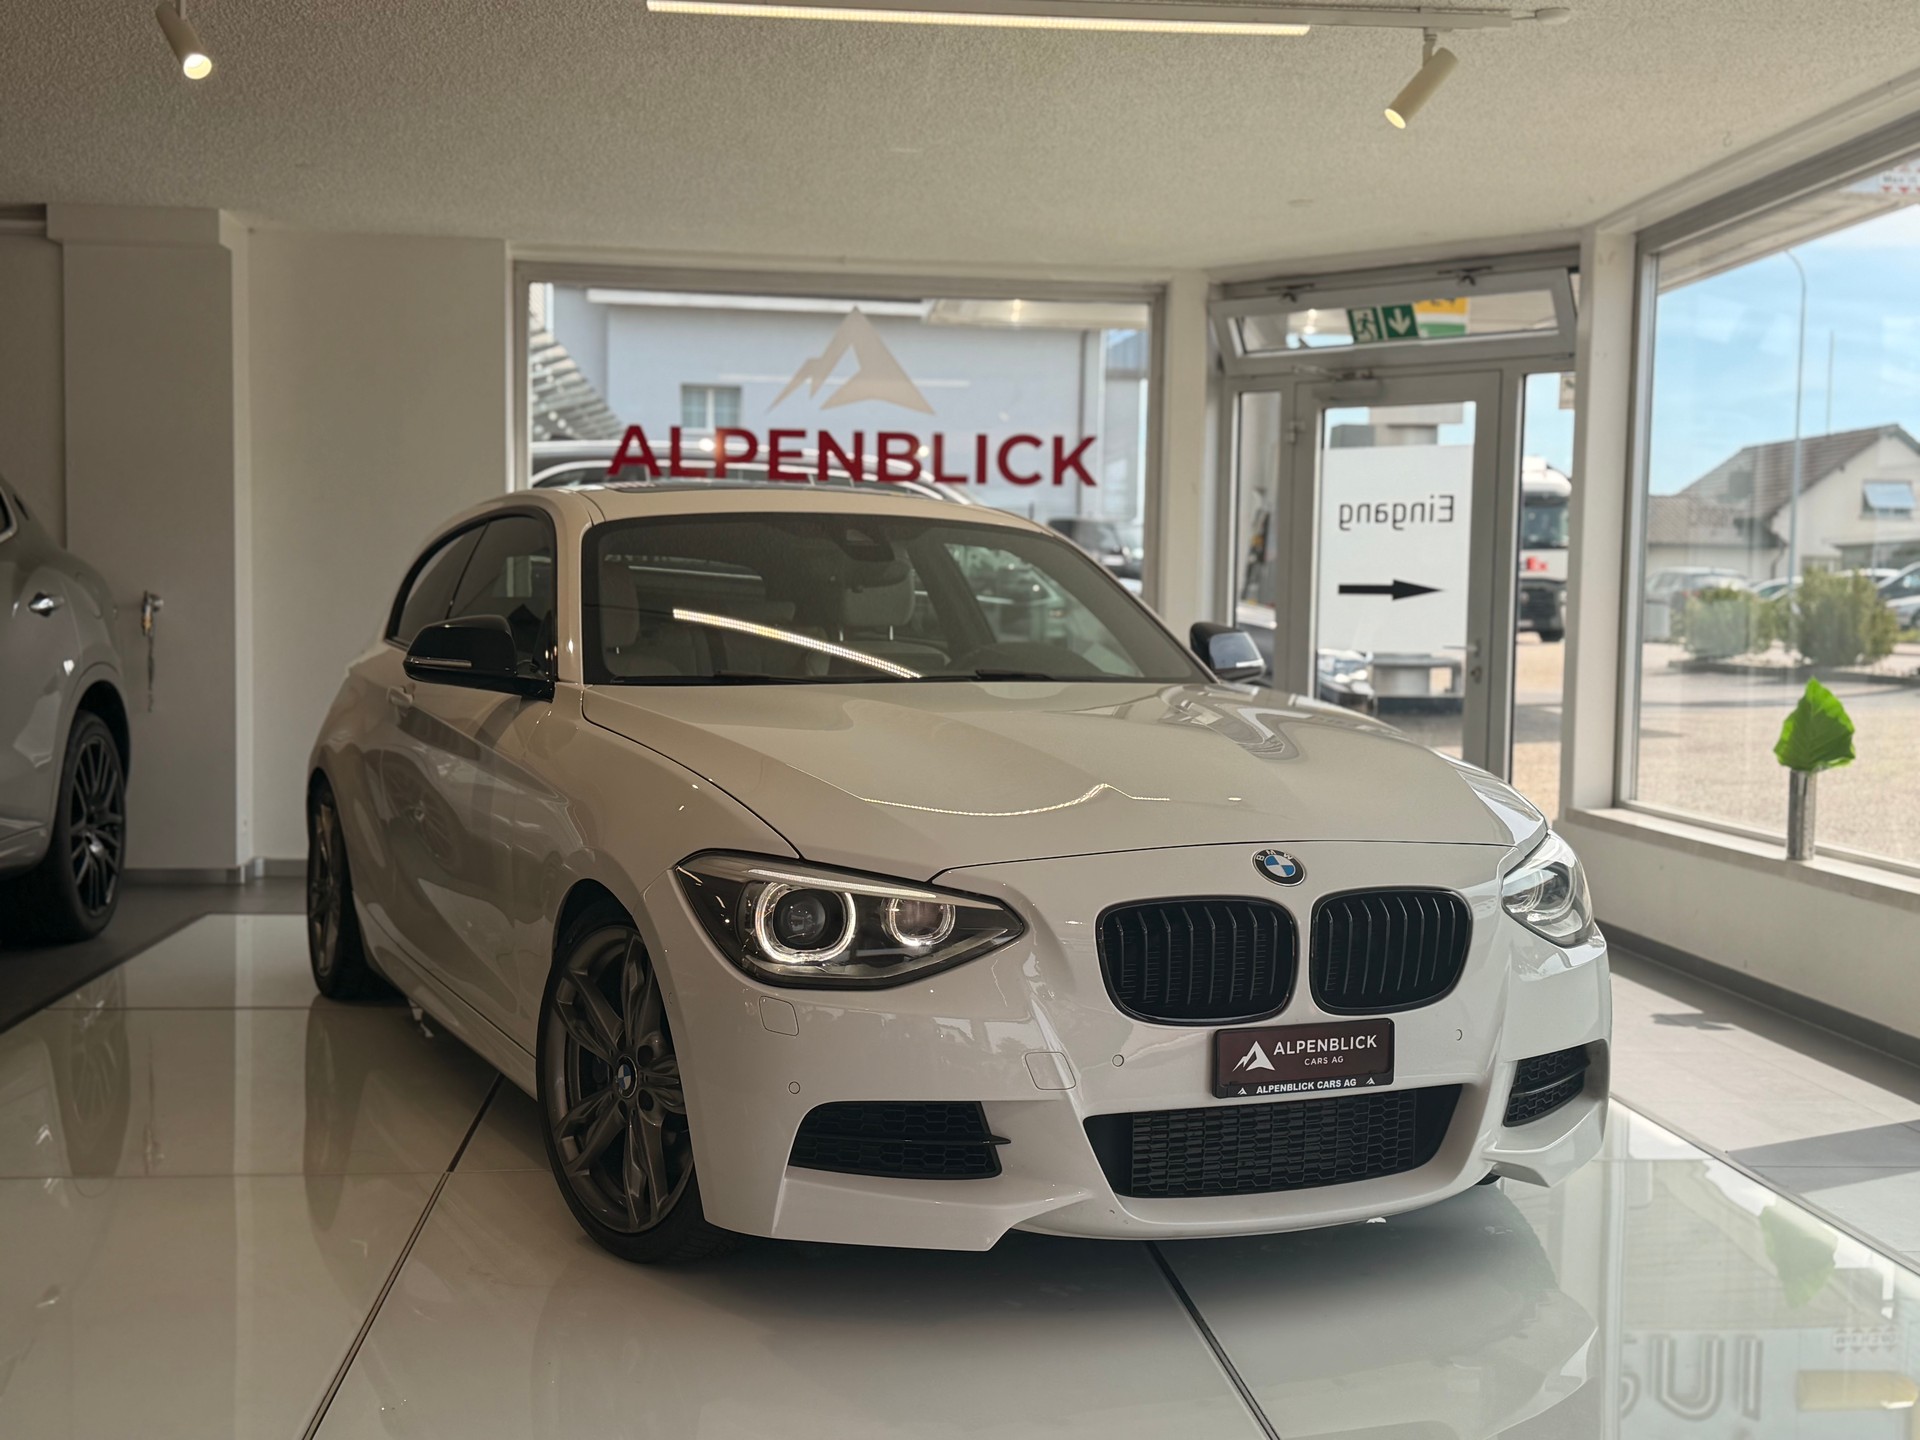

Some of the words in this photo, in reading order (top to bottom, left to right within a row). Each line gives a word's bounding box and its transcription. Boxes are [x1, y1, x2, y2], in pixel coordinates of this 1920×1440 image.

[608, 425, 1097, 487] ALPENBLICK
[1273, 1035, 1377, 1056] ALPENBLICK
[1304, 1057, 1329, 1066] CARS
[1331, 1055, 1343, 1064] AG
[1256, 1082, 1315, 1094] ALPENBLICK
[1317, 1079, 1342, 1090] CARS
[1343, 1078, 1357, 1087] AG
